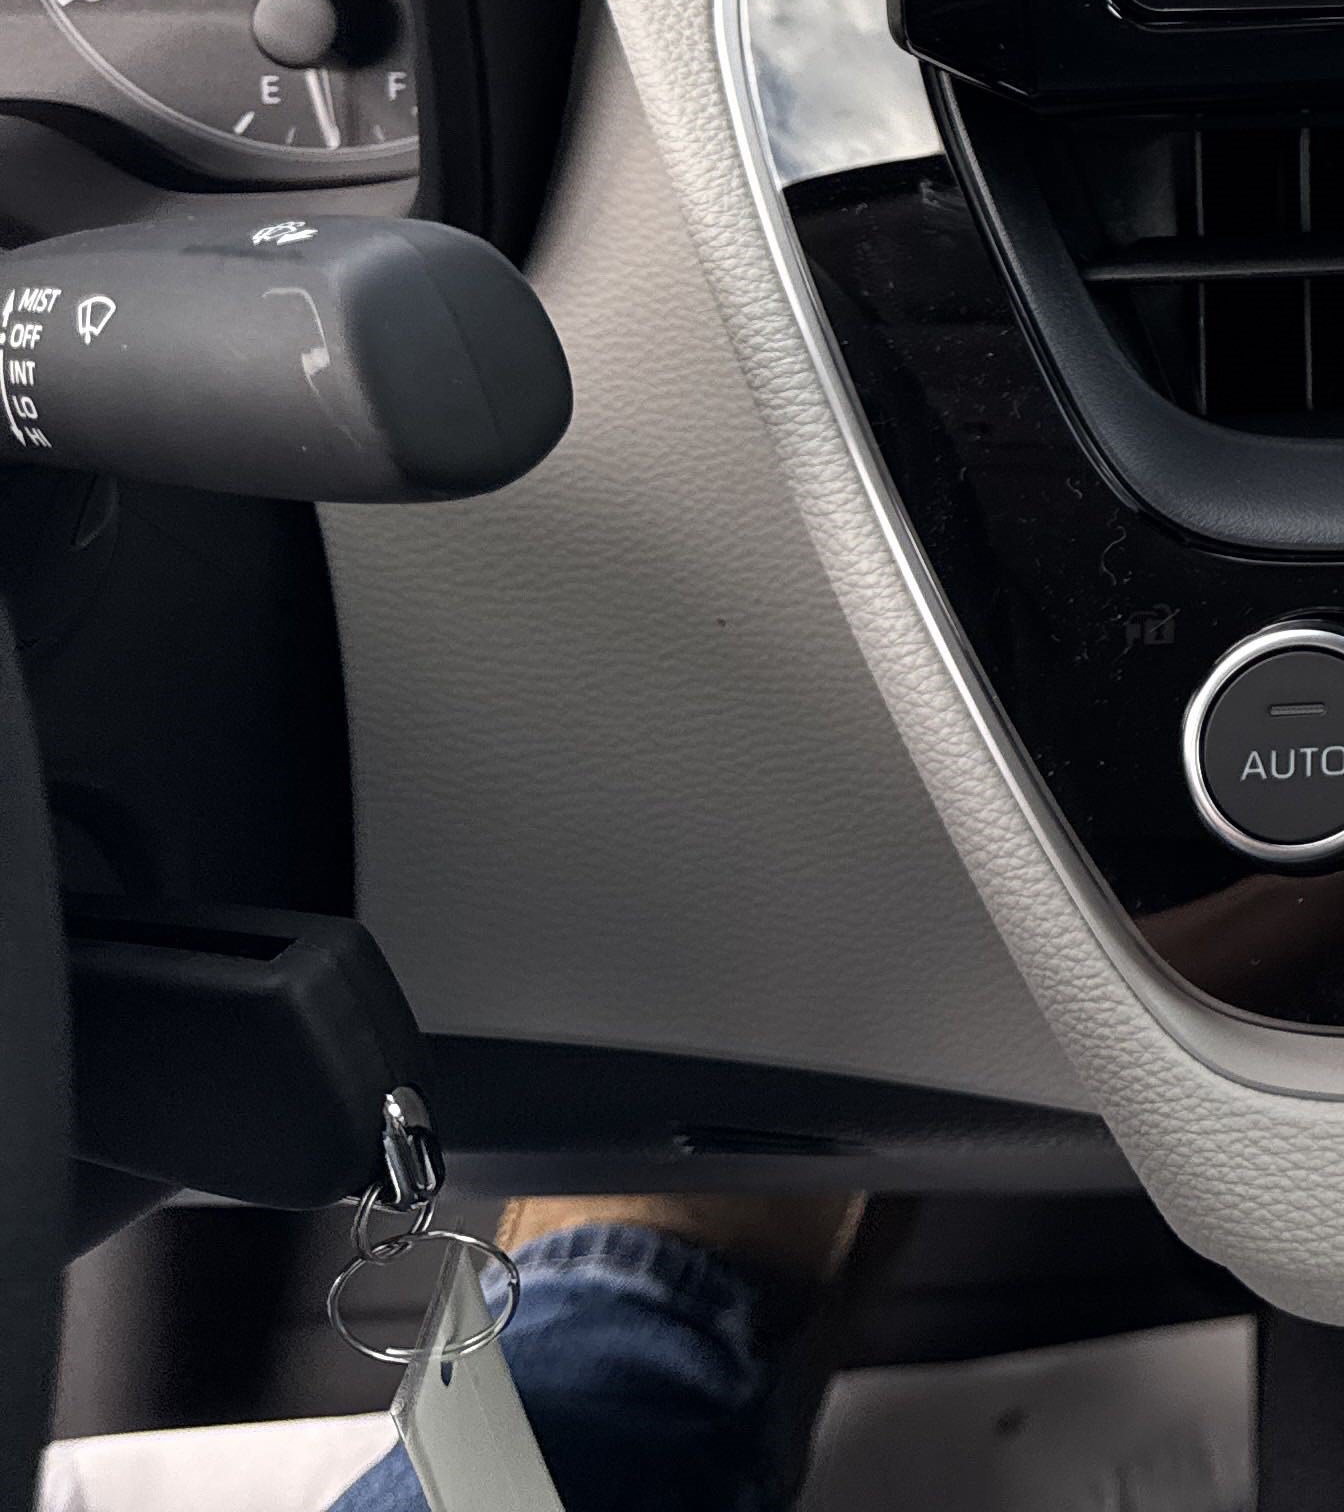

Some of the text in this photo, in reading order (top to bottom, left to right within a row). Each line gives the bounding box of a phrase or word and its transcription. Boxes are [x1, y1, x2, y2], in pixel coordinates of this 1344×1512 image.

[260, 75, 281, 105] E
[388, 71, 407, 101] F
[18, 288, 62, 313] MIST
[9, 323, 43, 350] OFF
[9, 360, 36, 386] INT
[12, 395, 39, 420] LO
[24, 426, 53, 448] HI
